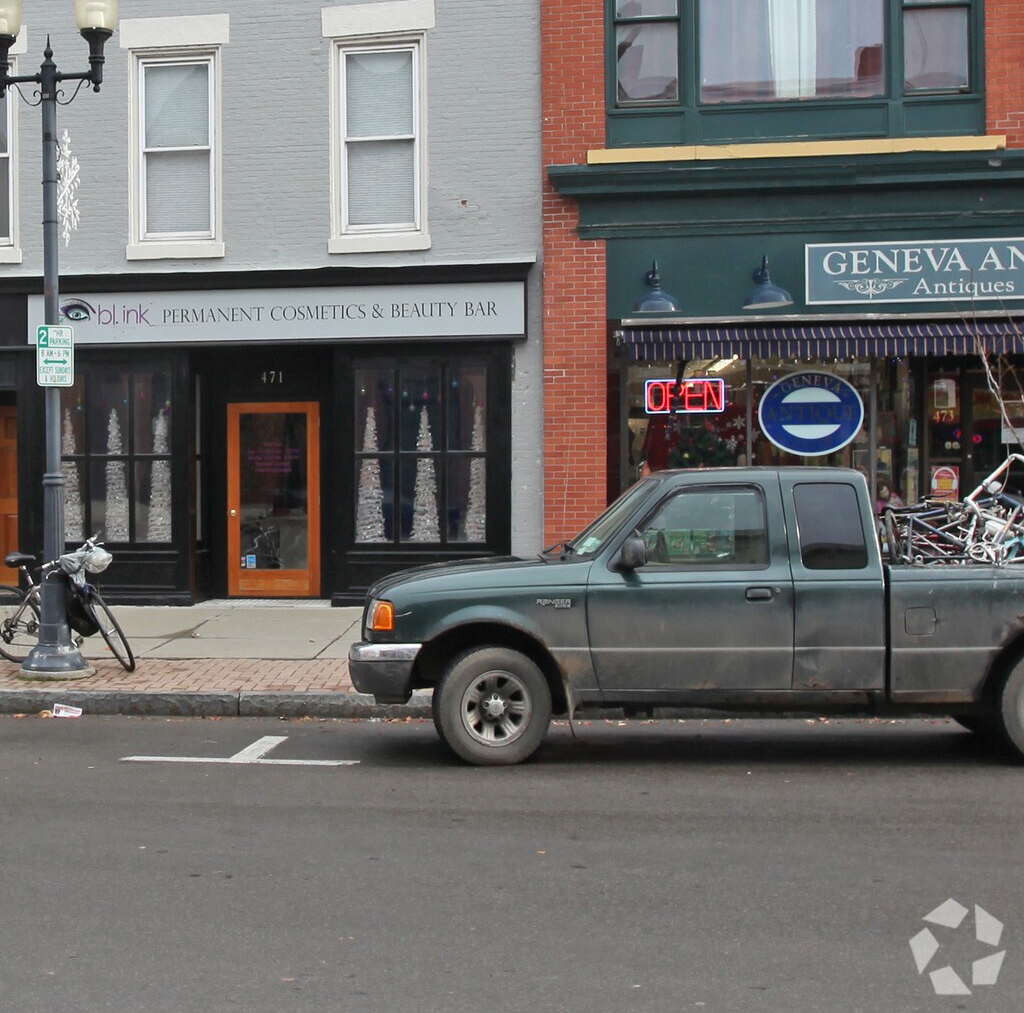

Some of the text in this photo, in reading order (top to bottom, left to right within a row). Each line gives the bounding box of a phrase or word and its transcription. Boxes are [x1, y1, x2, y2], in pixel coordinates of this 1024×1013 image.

[822, 247, 973, 275] GENEVA
[912, 277, 1015, 297] Antiques
[163, 306, 264, 324] PERMANENT
[270, 303, 366, 321] COSMETICS
[371, 303, 384, 319] &
[391, 302, 458, 318] BEAUTY
[465, 301, 498, 317] BAR
[38, 329, 48, 345] 2
[49, 338, 71, 346] PARKING
[261, 371, 283, 383] 471
[780, 374, 842, 393] GENEVA
[647, 381, 722, 411] OPEN
[933, 410, 954, 423] 473
